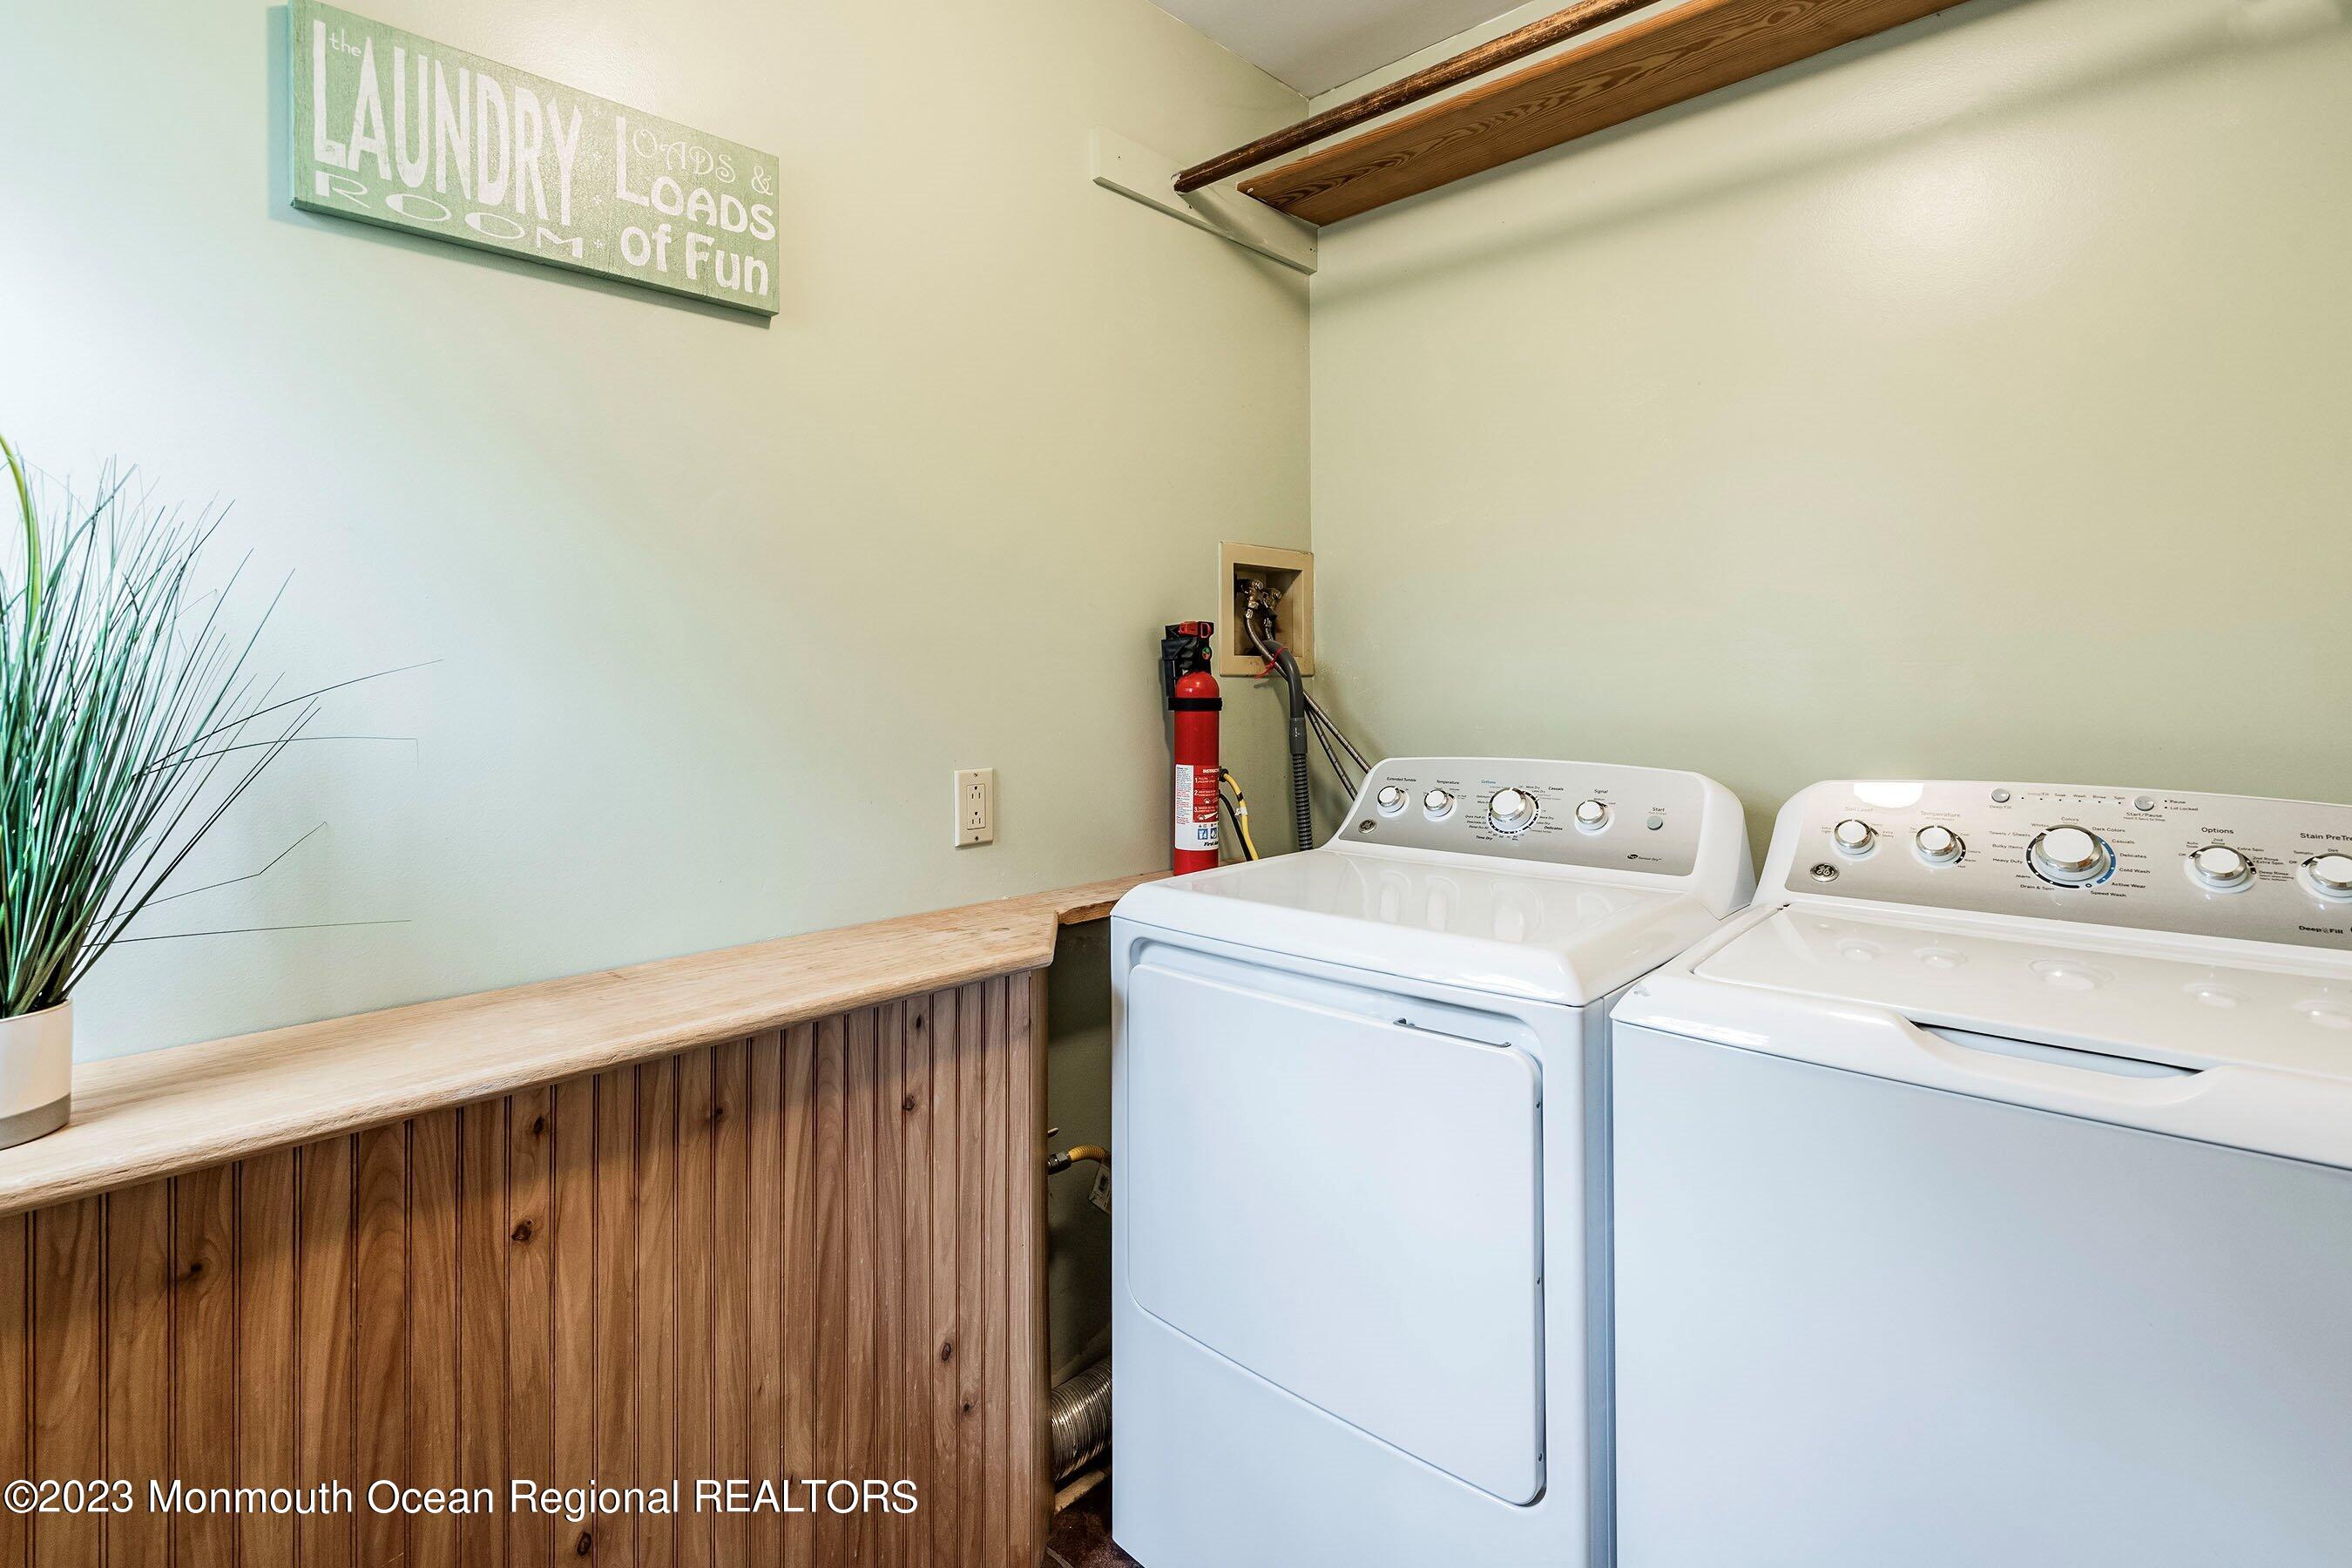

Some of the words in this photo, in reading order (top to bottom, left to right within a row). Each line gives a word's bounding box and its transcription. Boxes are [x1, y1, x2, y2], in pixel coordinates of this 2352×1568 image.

[329, 29, 362, 56] the
[314, 19, 583, 226] LAUNDRY
[751, 165, 774, 196] &
[315, 170, 583, 259] ROOM
[686, 232, 769, 296] Fun
